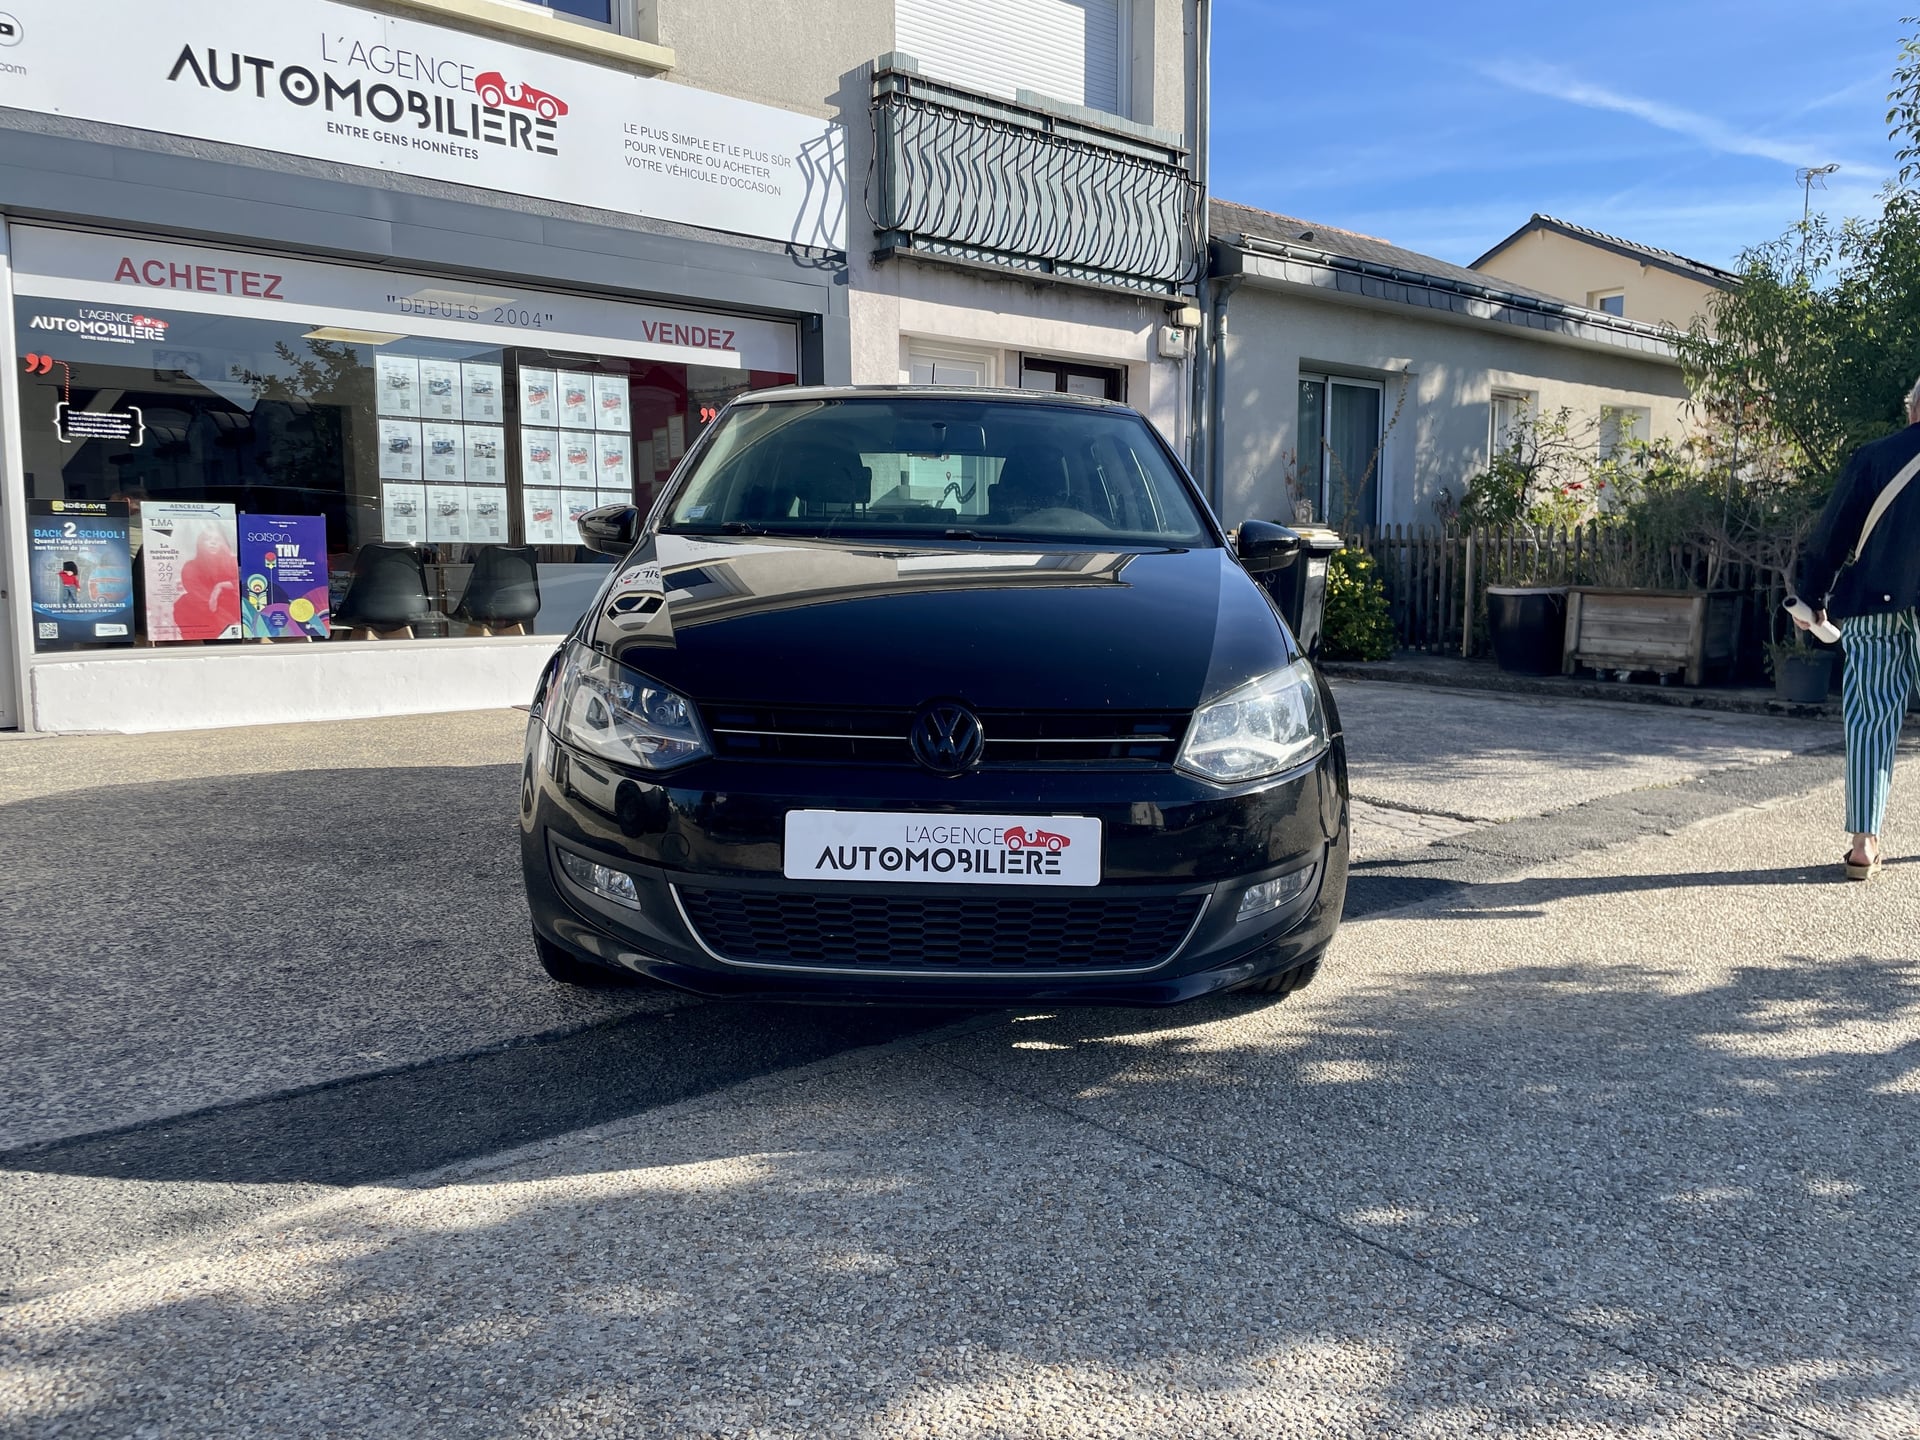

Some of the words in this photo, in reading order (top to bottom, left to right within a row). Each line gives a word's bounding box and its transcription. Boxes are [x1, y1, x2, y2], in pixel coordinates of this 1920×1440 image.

[321, 32, 475, 93] L'AGENCE
[327, 122, 370, 140] ENTRE
[373, 130, 409, 147] GENS
[412, 138, 479, 160] HONNÊTES
[624, 122, 637, 135] LE
[640, 126, 669, 142] PLUS
[671, 133, 710, 151] SIMPLE
[713, 142, 726, 154] ET
[728, 145, 741, 157] LE
[743, 148, 769, 164] PLUS
[771, 153, 792, 169] SÛR
[624, 139, 656, 154] POUR
[659, 146, 703, 165] VENDRE
[705, 156, 722, 169] OU
[723, 159, 770, 179] ACHETER
[624, 156, 663, 173] VOTRE
[665, 162, 718, 184] VÉHICULE
[720, 175, 781, 196] D'OCCASION
[114, 256, 284, 300] ACHETEZ
[79, 308, 134, 324] L'AGENCE
[641, 319, 736, 351] VENDEZ
[34, 529, 62, 538] BACK
[64, 522, 77, 538] 2
[79, 530, 120, 539] SCHOOL
[275, 544, 300, 557] THV
[158, 562, 173, 572] 26
[158, 572, 173, 582] 27
[905, 825, 1004, 846] L'AGENCE
